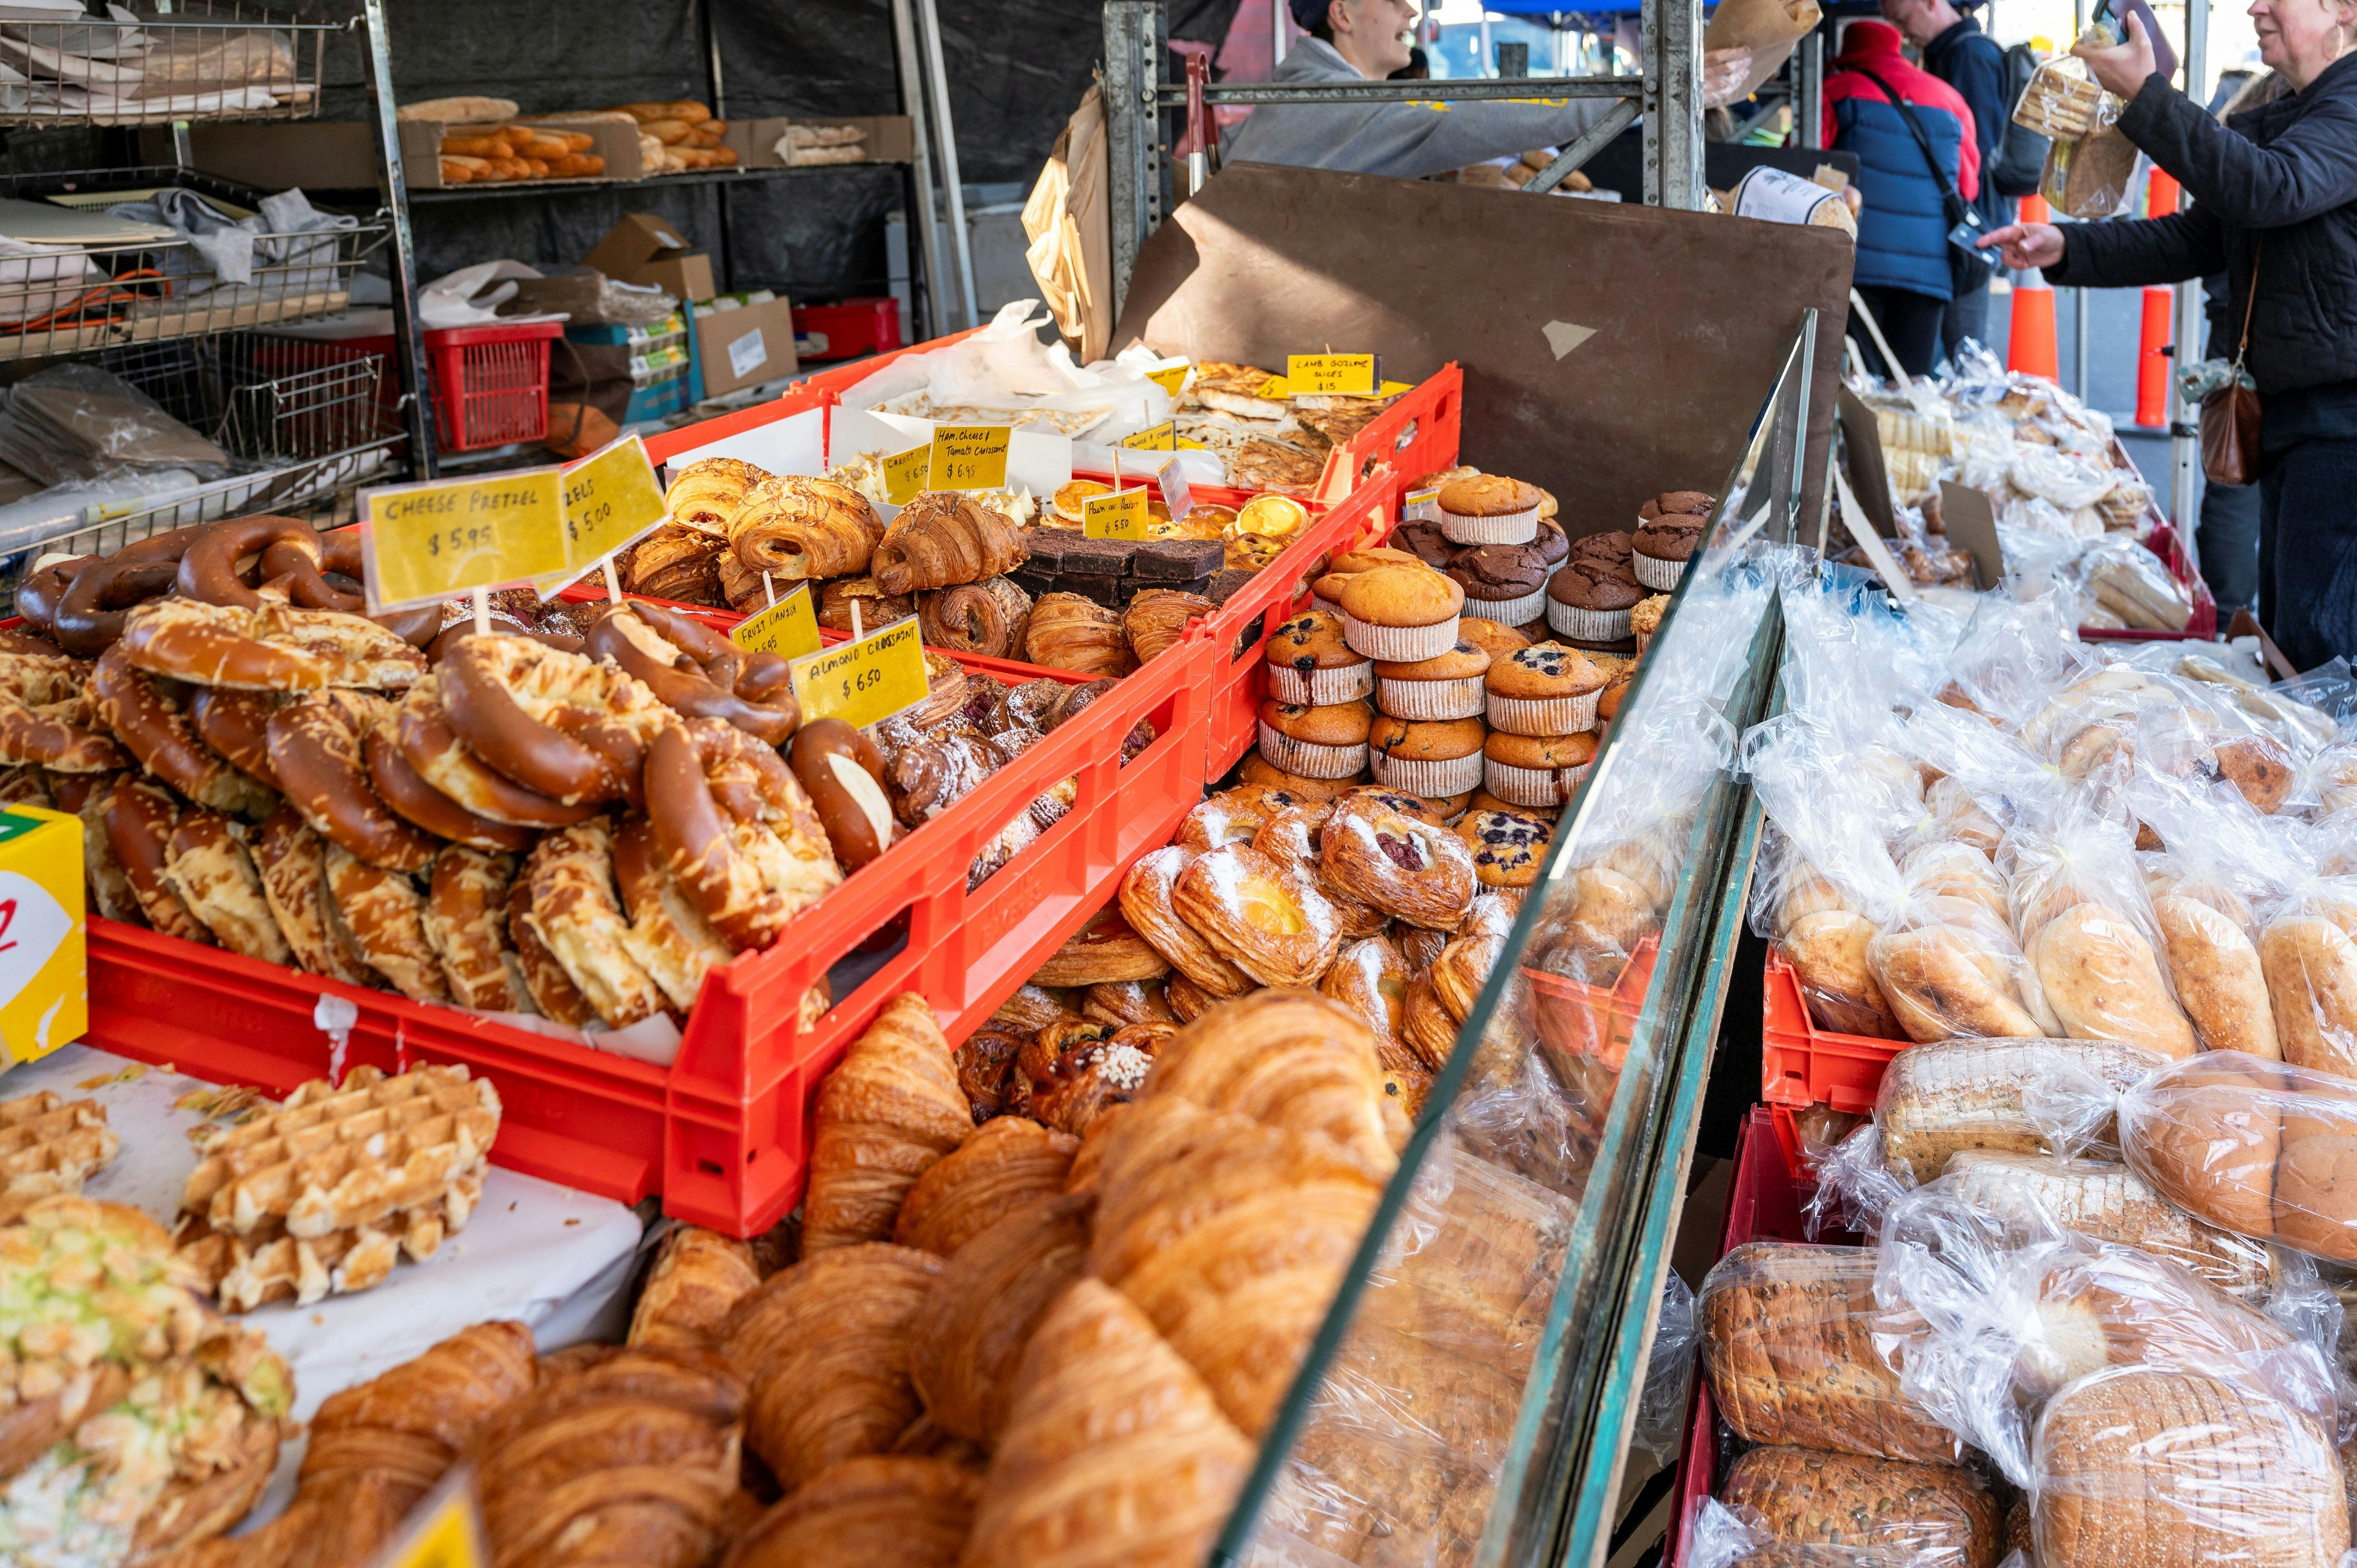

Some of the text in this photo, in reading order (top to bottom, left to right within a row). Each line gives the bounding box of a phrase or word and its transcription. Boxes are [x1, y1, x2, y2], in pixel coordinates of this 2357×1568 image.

[1296, 360, 1323, 368] LAMB
[888, 452, 914, 468] CARROT
[385, 492, 458, 520] CHEESE
[563, 478, 594, 506] ZELS
[742, 603, 797, 643] FRUIT DANISH
[810, 648, 859, 680] ALMOND
